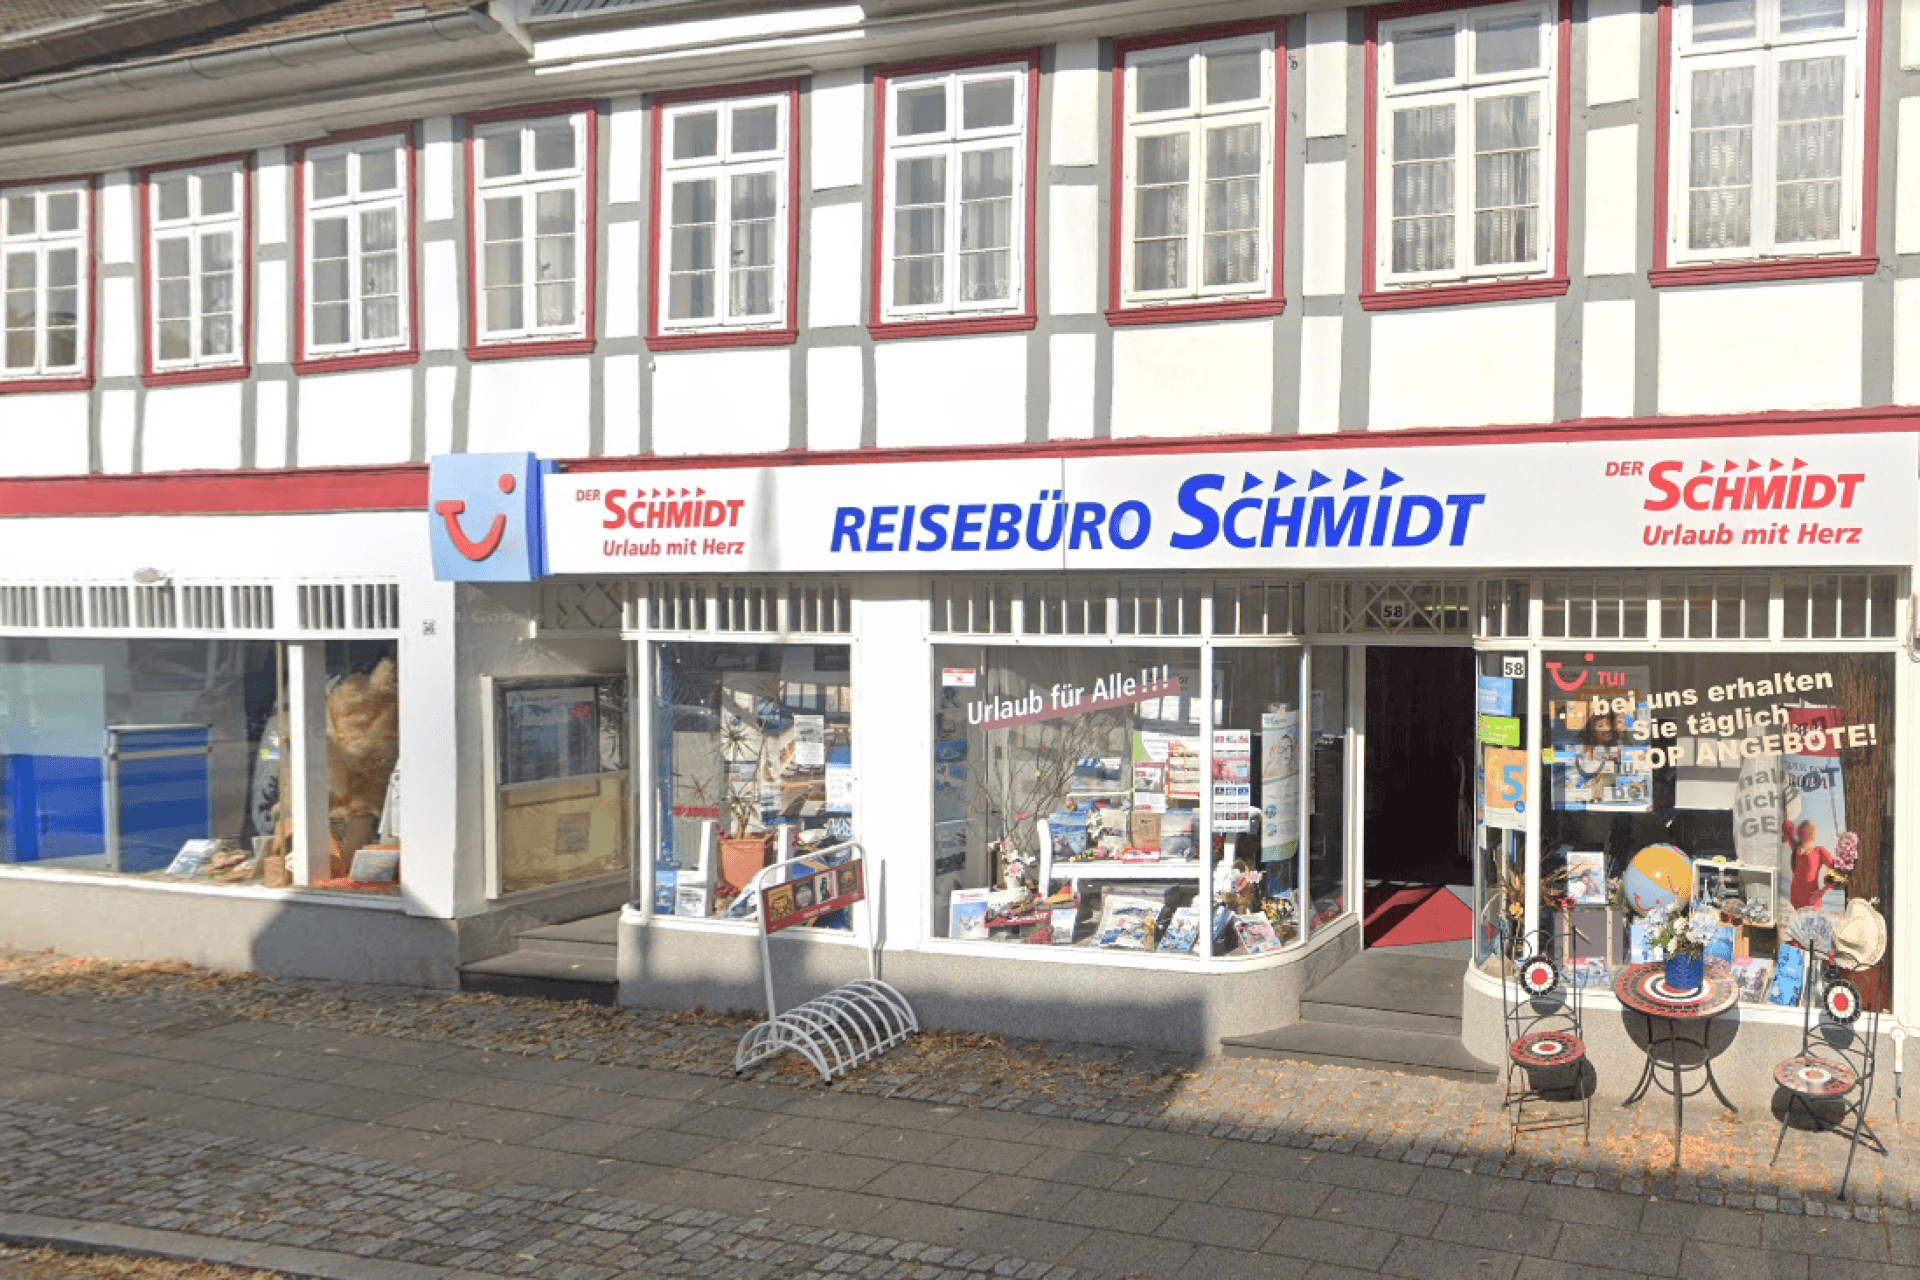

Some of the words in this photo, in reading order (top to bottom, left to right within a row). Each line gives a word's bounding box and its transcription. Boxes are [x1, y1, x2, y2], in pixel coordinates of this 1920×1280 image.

[1605, 461, 1644, 477] DER
[1643, 459, 1866, 511] SCHMIDT
[576, 489, 601, 501] DER
[603, 488, 745, 529] SCHMIDT
[830, 489, 1152, 553] REISEBÜRO
[1170, 473, 1486, 549] SCHMIDT
[603, 540, 661, 557] Urlaub
[667, 541, 697, 556] mit
[702, 539, 745, 555] Herz
[1643, 523, 1734, 546] Urlaub
[1742, 523, 1789, 545] mit
[1797, 523, 1863, 545] Herz
[1383, 604, 1403, 618] 58
[1504, 662, 1523, 676] 58
[1597, 670, 1627, 687] TUI
[967, 688, 1043, 725] Urlaub
[1050, 683, 1084, 711] für
[1592, 689, 1636, 716] bei
[1646, 688, 1699, 709] uns
[1707, 671, 1834, 703] erhalten
[1632, 717, 1678, 741] Sie
[1687, 703, 1790, 737] täglich
[1625, 746, 1685, 772] TOP
